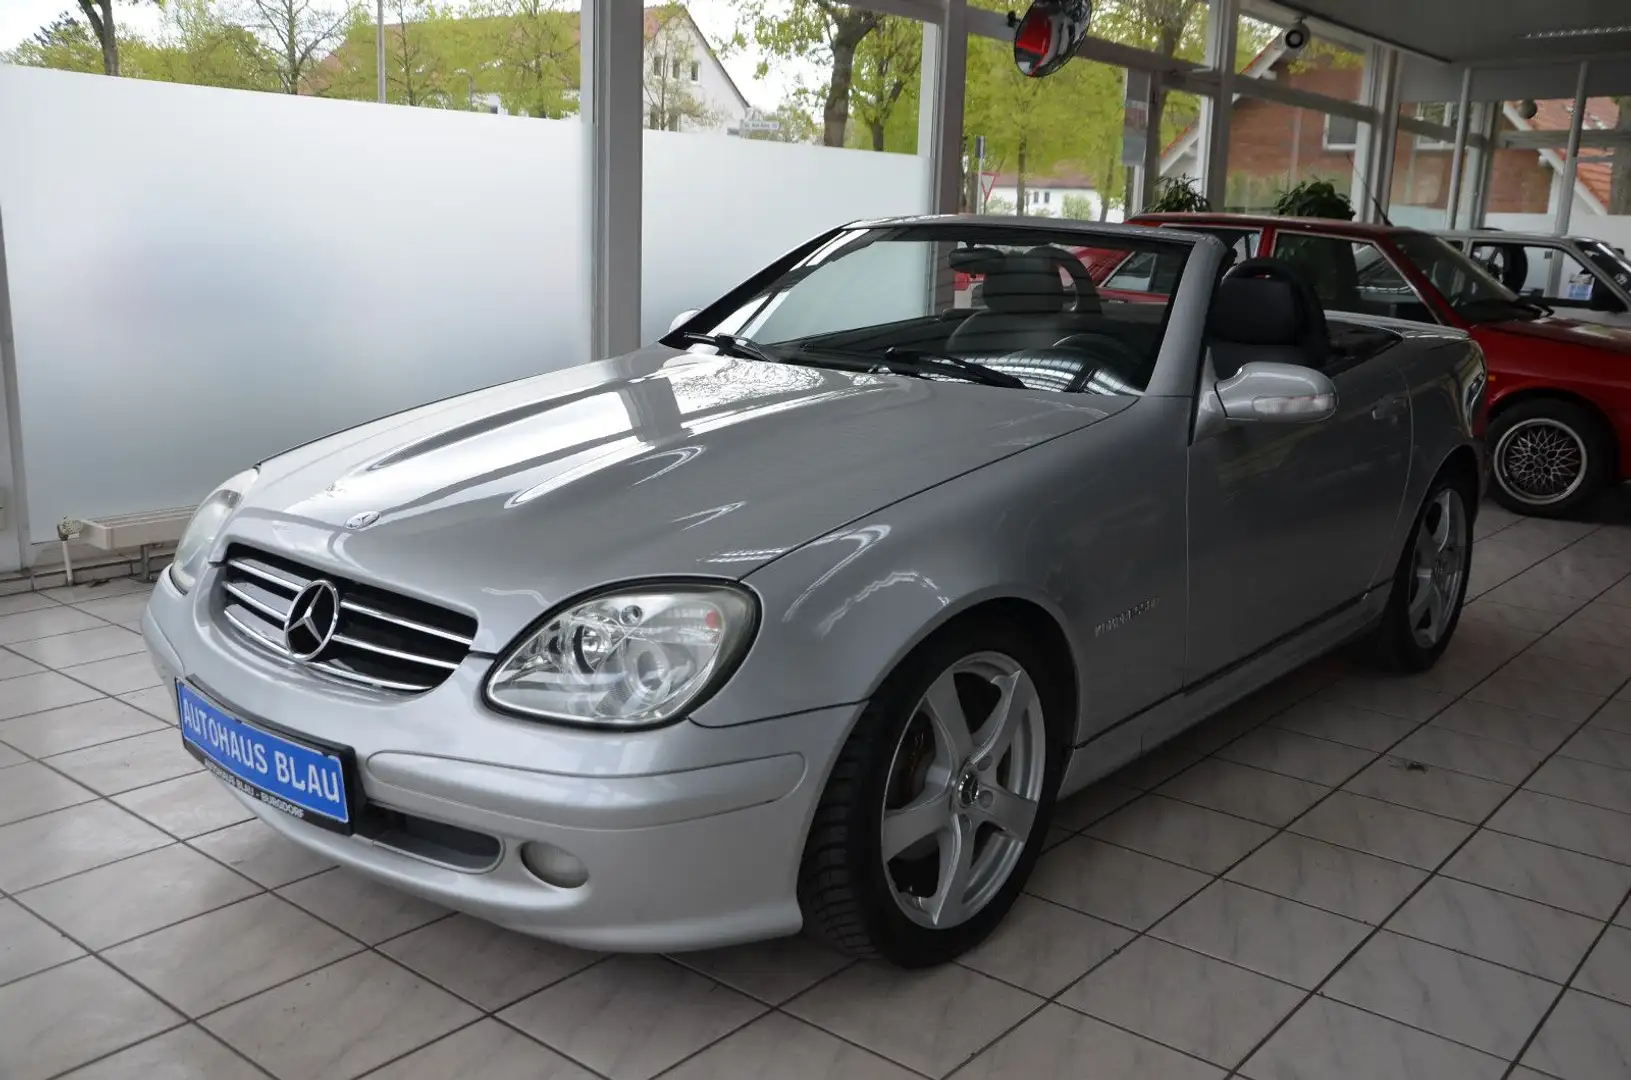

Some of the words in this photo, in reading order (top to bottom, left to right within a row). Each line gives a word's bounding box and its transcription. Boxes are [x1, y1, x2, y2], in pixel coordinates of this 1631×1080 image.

[182, 698, 268, 774] AUTOHAUS
[274, 751, 340, 803] BLAU
[235, 779, 255, 796] BLAU
